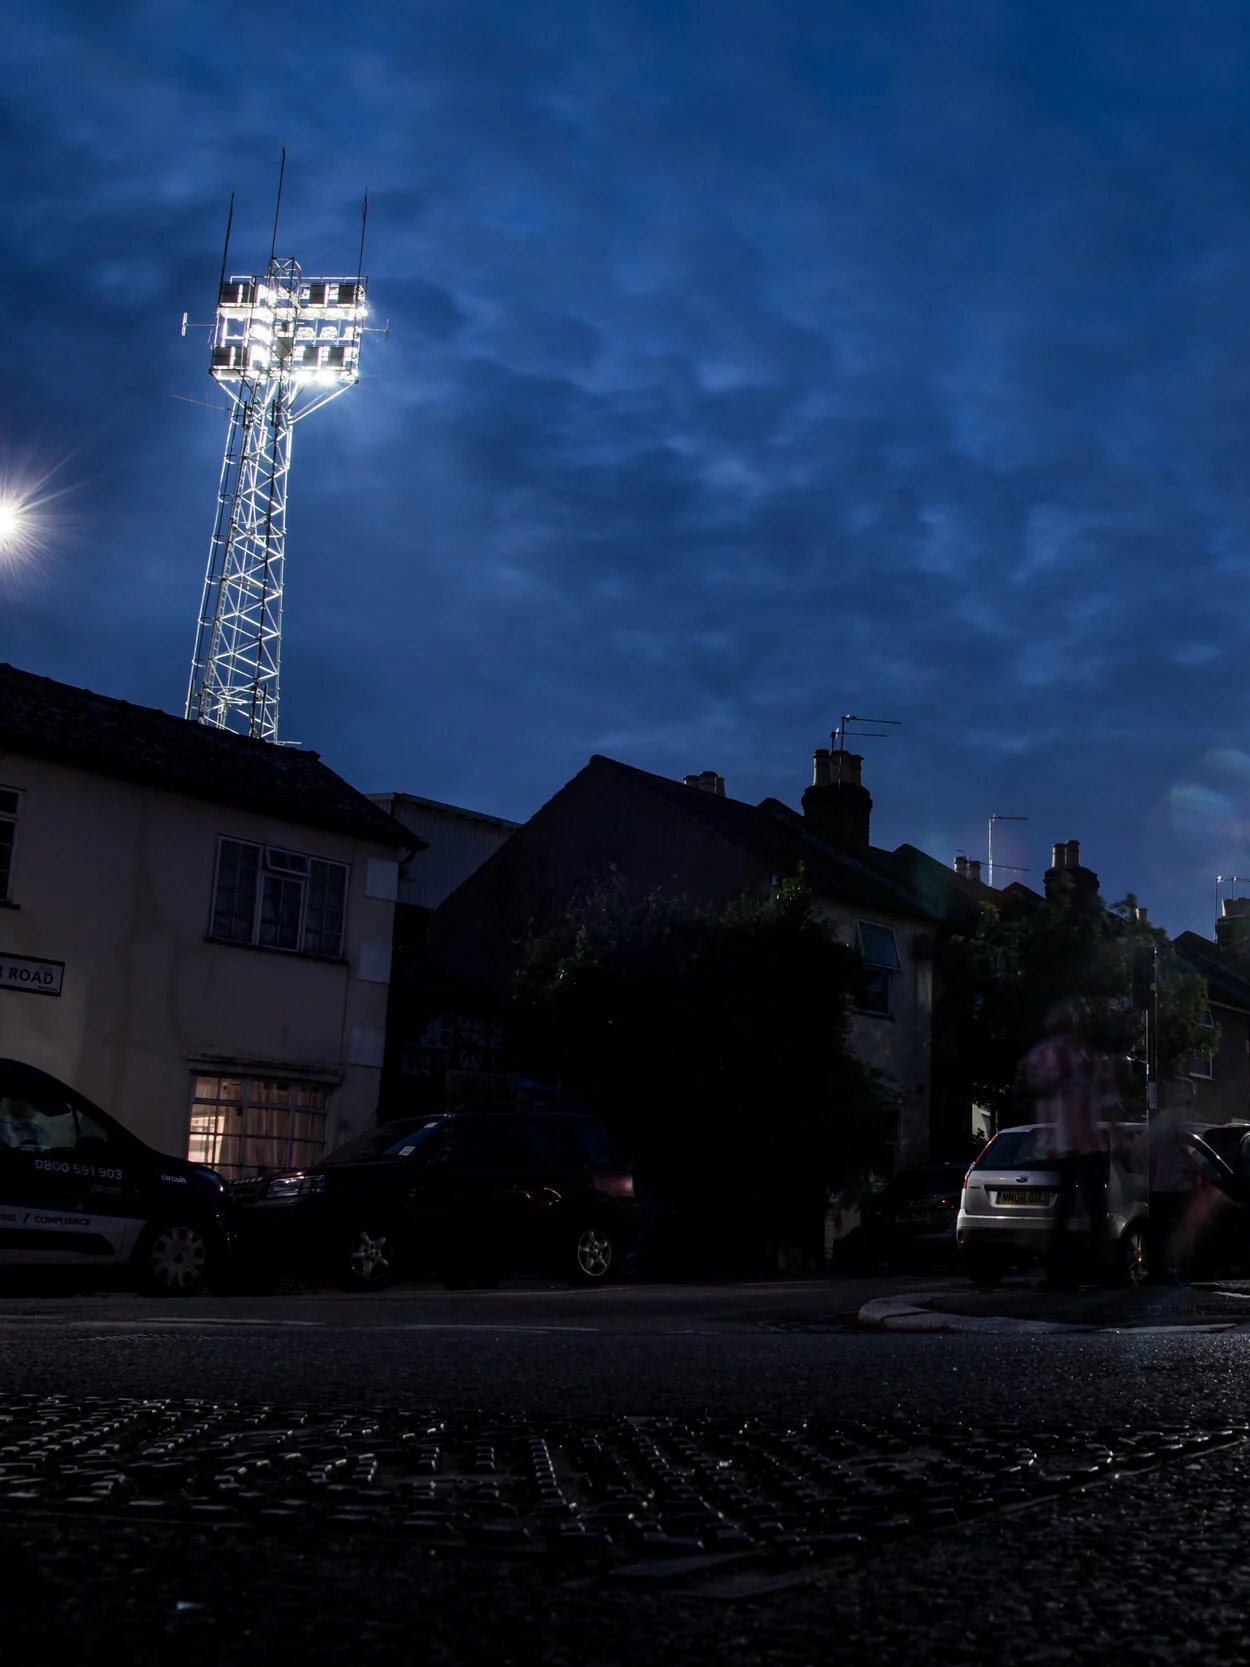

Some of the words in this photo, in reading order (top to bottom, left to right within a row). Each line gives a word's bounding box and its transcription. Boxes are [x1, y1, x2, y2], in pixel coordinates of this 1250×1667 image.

[9, 967, 54, 985] ROAD
[34, 1158, 70, 1173] 0800
[73, 1163, 96, 1176] 591
[99, 1167, 123, 1180] 903
[34, 1215, 91, 1226] COMPLIANCE
